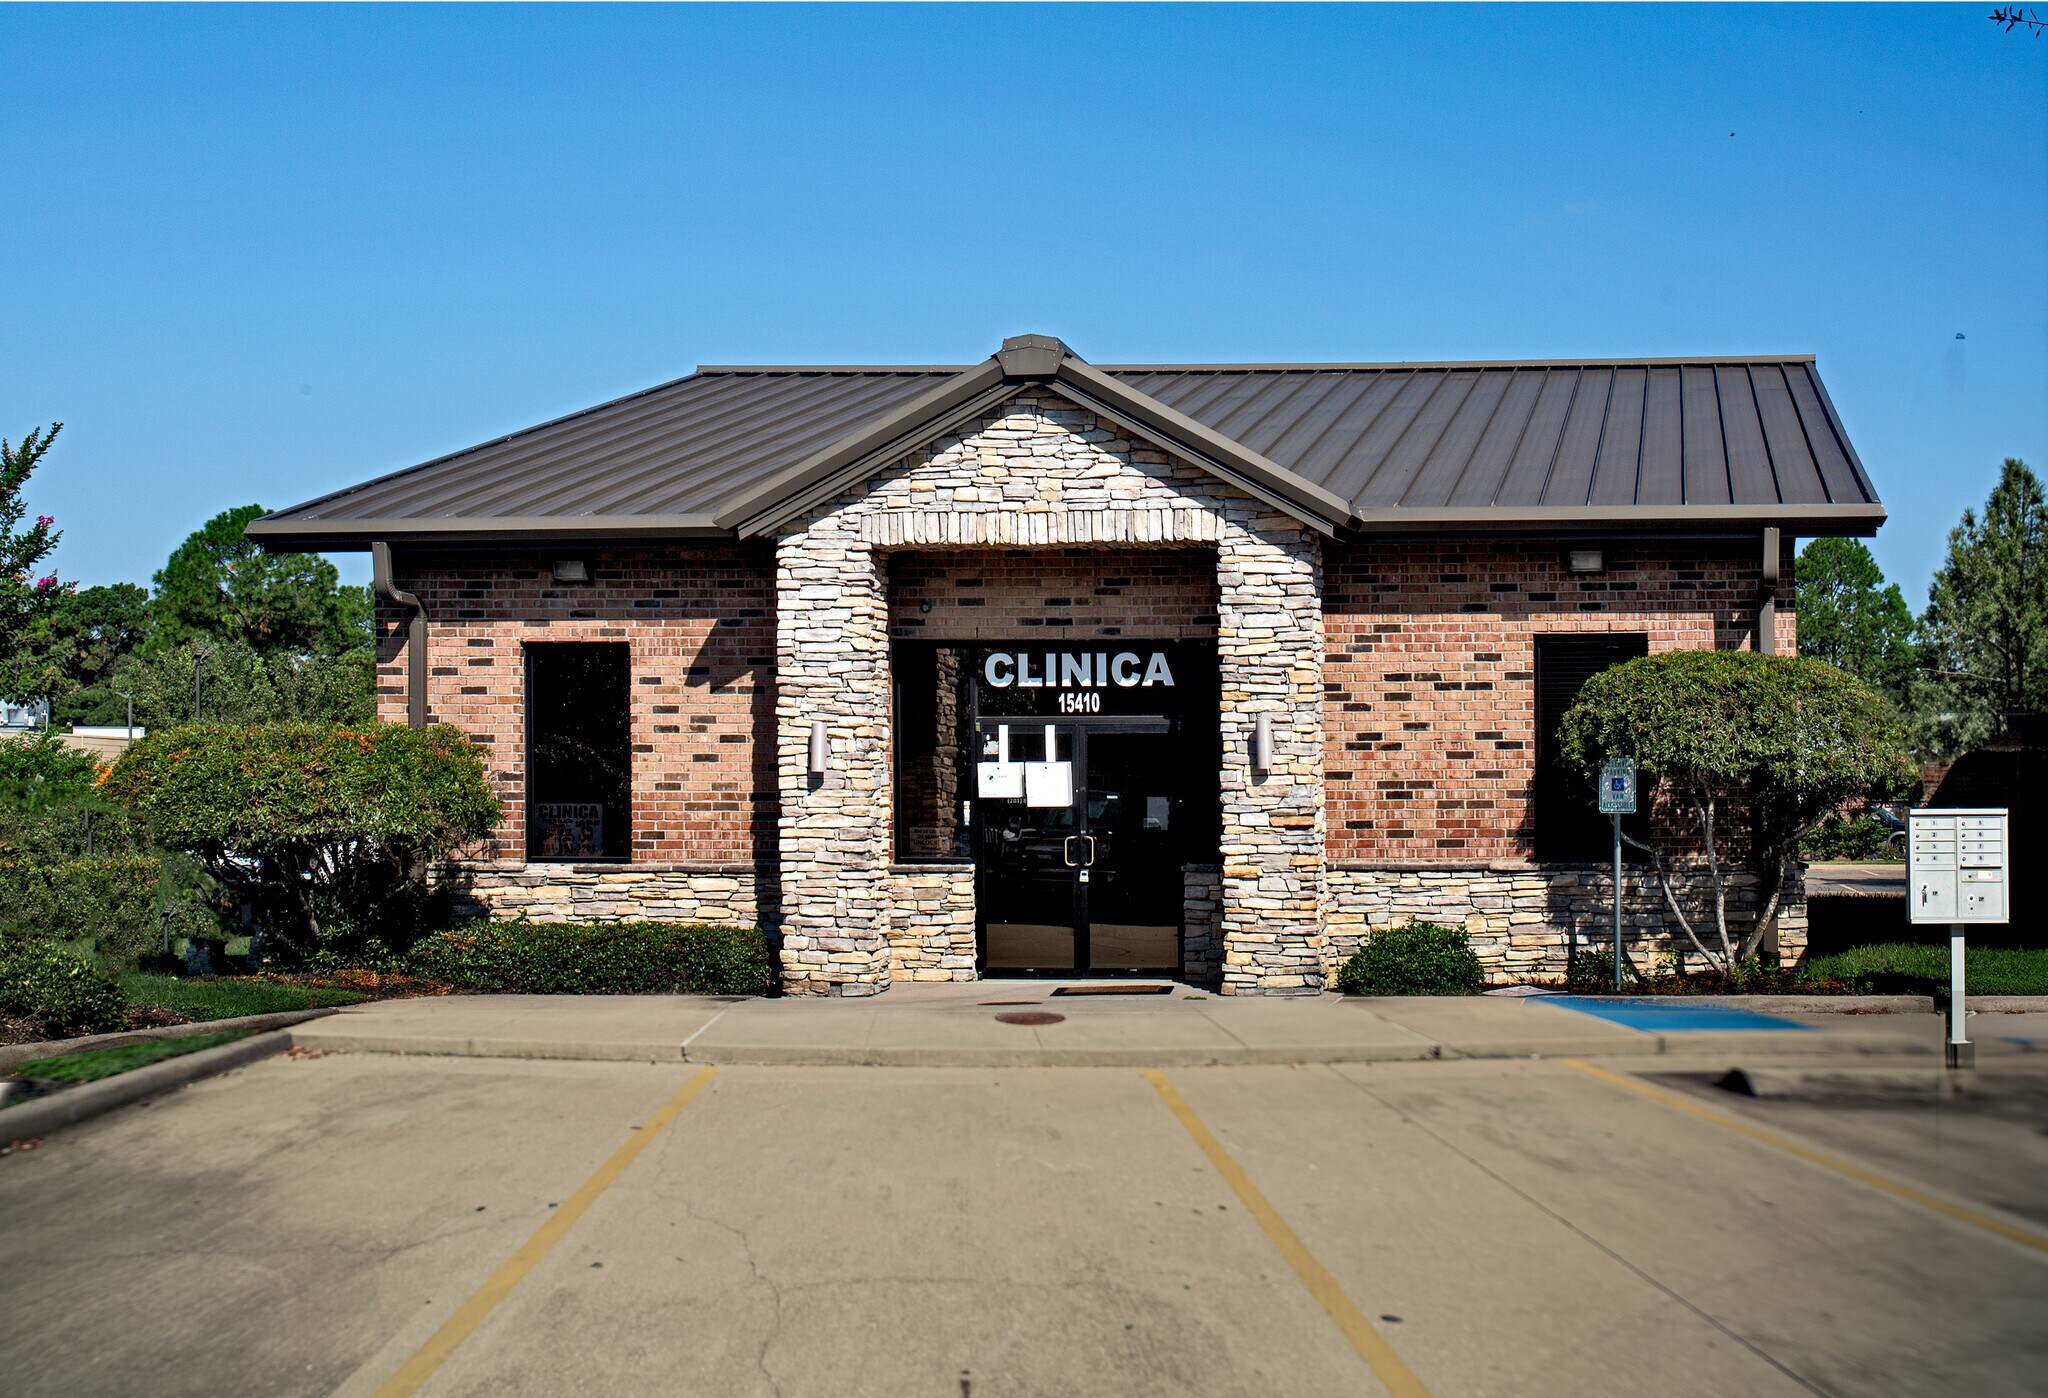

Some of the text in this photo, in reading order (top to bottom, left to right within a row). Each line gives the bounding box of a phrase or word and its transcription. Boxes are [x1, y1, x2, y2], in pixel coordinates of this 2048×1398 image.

[984, 652, 1175, 687] CLINICA
[1058, 692, 1101, 713] 15410
[1605, 768, 1630, 776] PARKING
[538, 805, 599, 819] CLINICA
[1603, 802, 1633, 810] ACCESSIBLE
